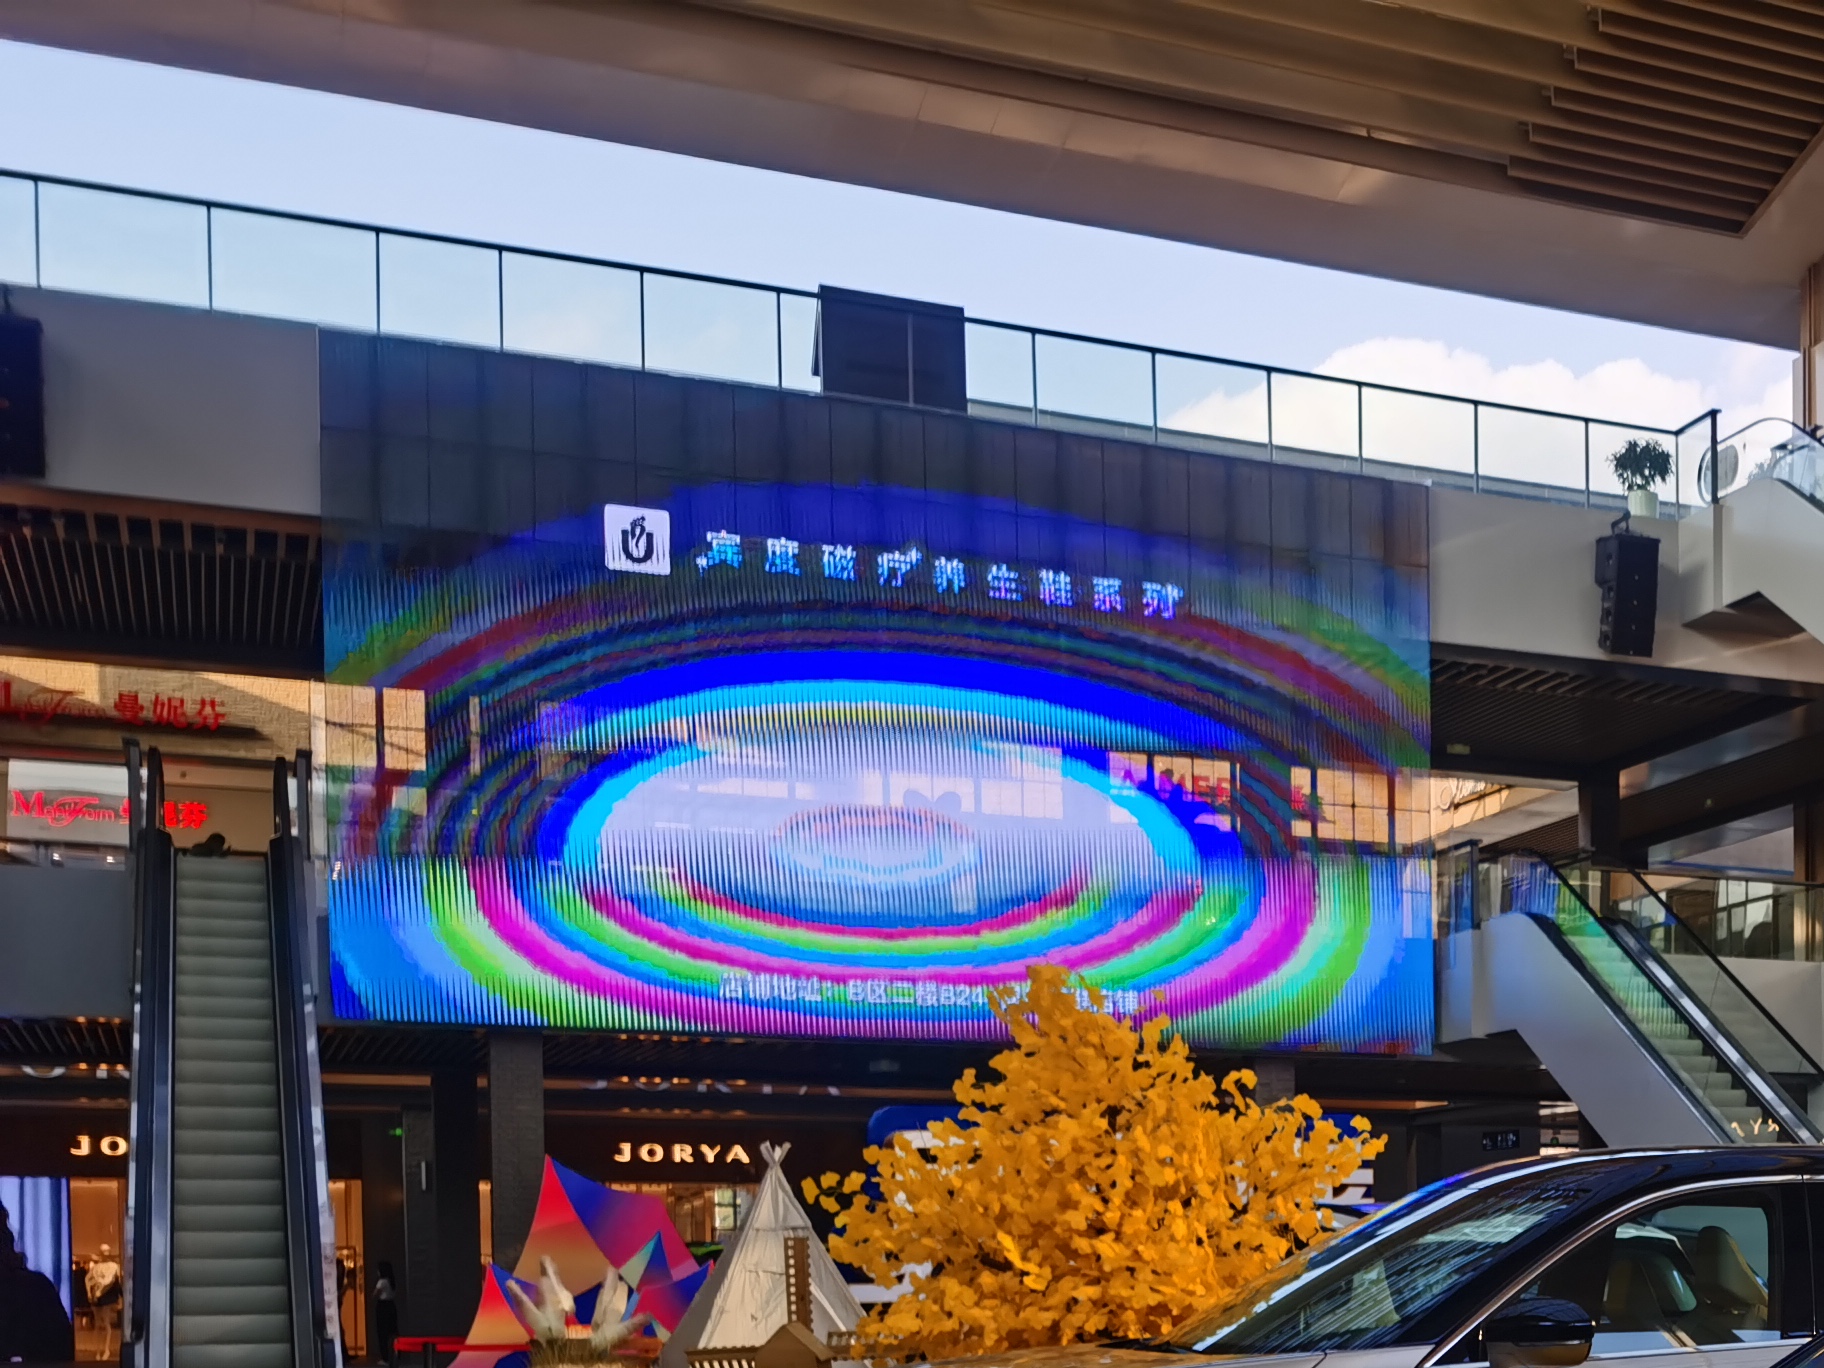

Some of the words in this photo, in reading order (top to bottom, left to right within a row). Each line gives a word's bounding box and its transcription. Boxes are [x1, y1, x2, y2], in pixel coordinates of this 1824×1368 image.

[114, 690, 226, 731] 曼妮芬
[614, 1142, 750, 1164] JORYA
